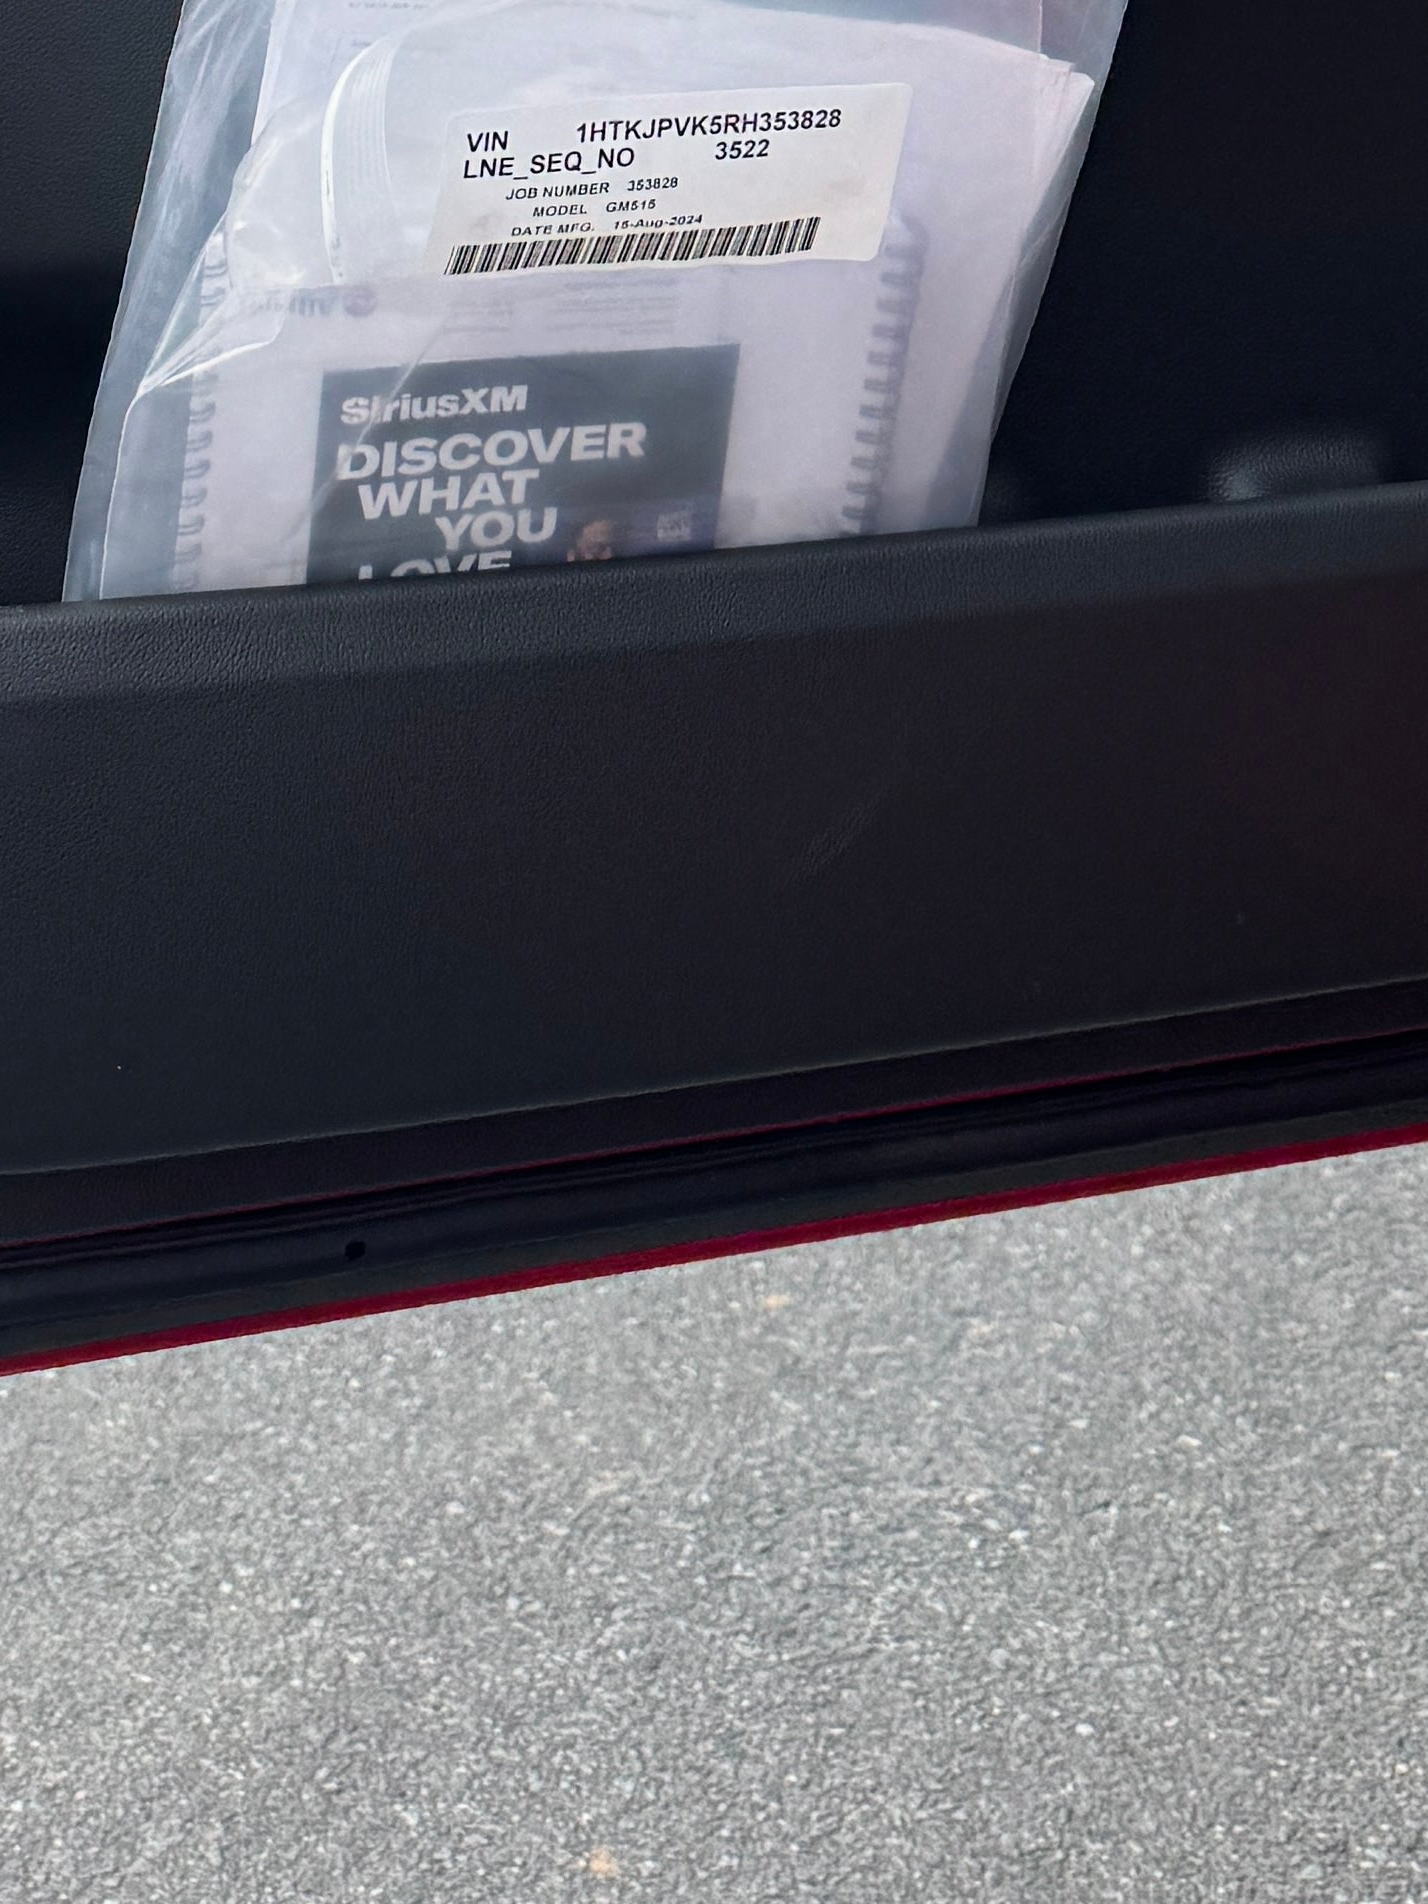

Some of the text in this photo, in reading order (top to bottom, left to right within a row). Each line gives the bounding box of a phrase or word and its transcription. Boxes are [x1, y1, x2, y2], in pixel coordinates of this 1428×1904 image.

[466, 108, 842, 153] VIN 1HTKJPVK5RH353828
[463, 138, 771, 180] LNE_SEQ_NO 3522
[506, 176, 679, 201] JOB NUMBER 353828
[511, 224, 552, 237] DATE
[557, 222, 595, 234] MFG.
[532, 204, 588, 218] MODEL
[340, 384, 528, 426] SiriusXM
[336, 422, 648, 482] DISCOVER
[357, 468, 540, 520] WHAT
[434, 506, 558, 553] YOU
